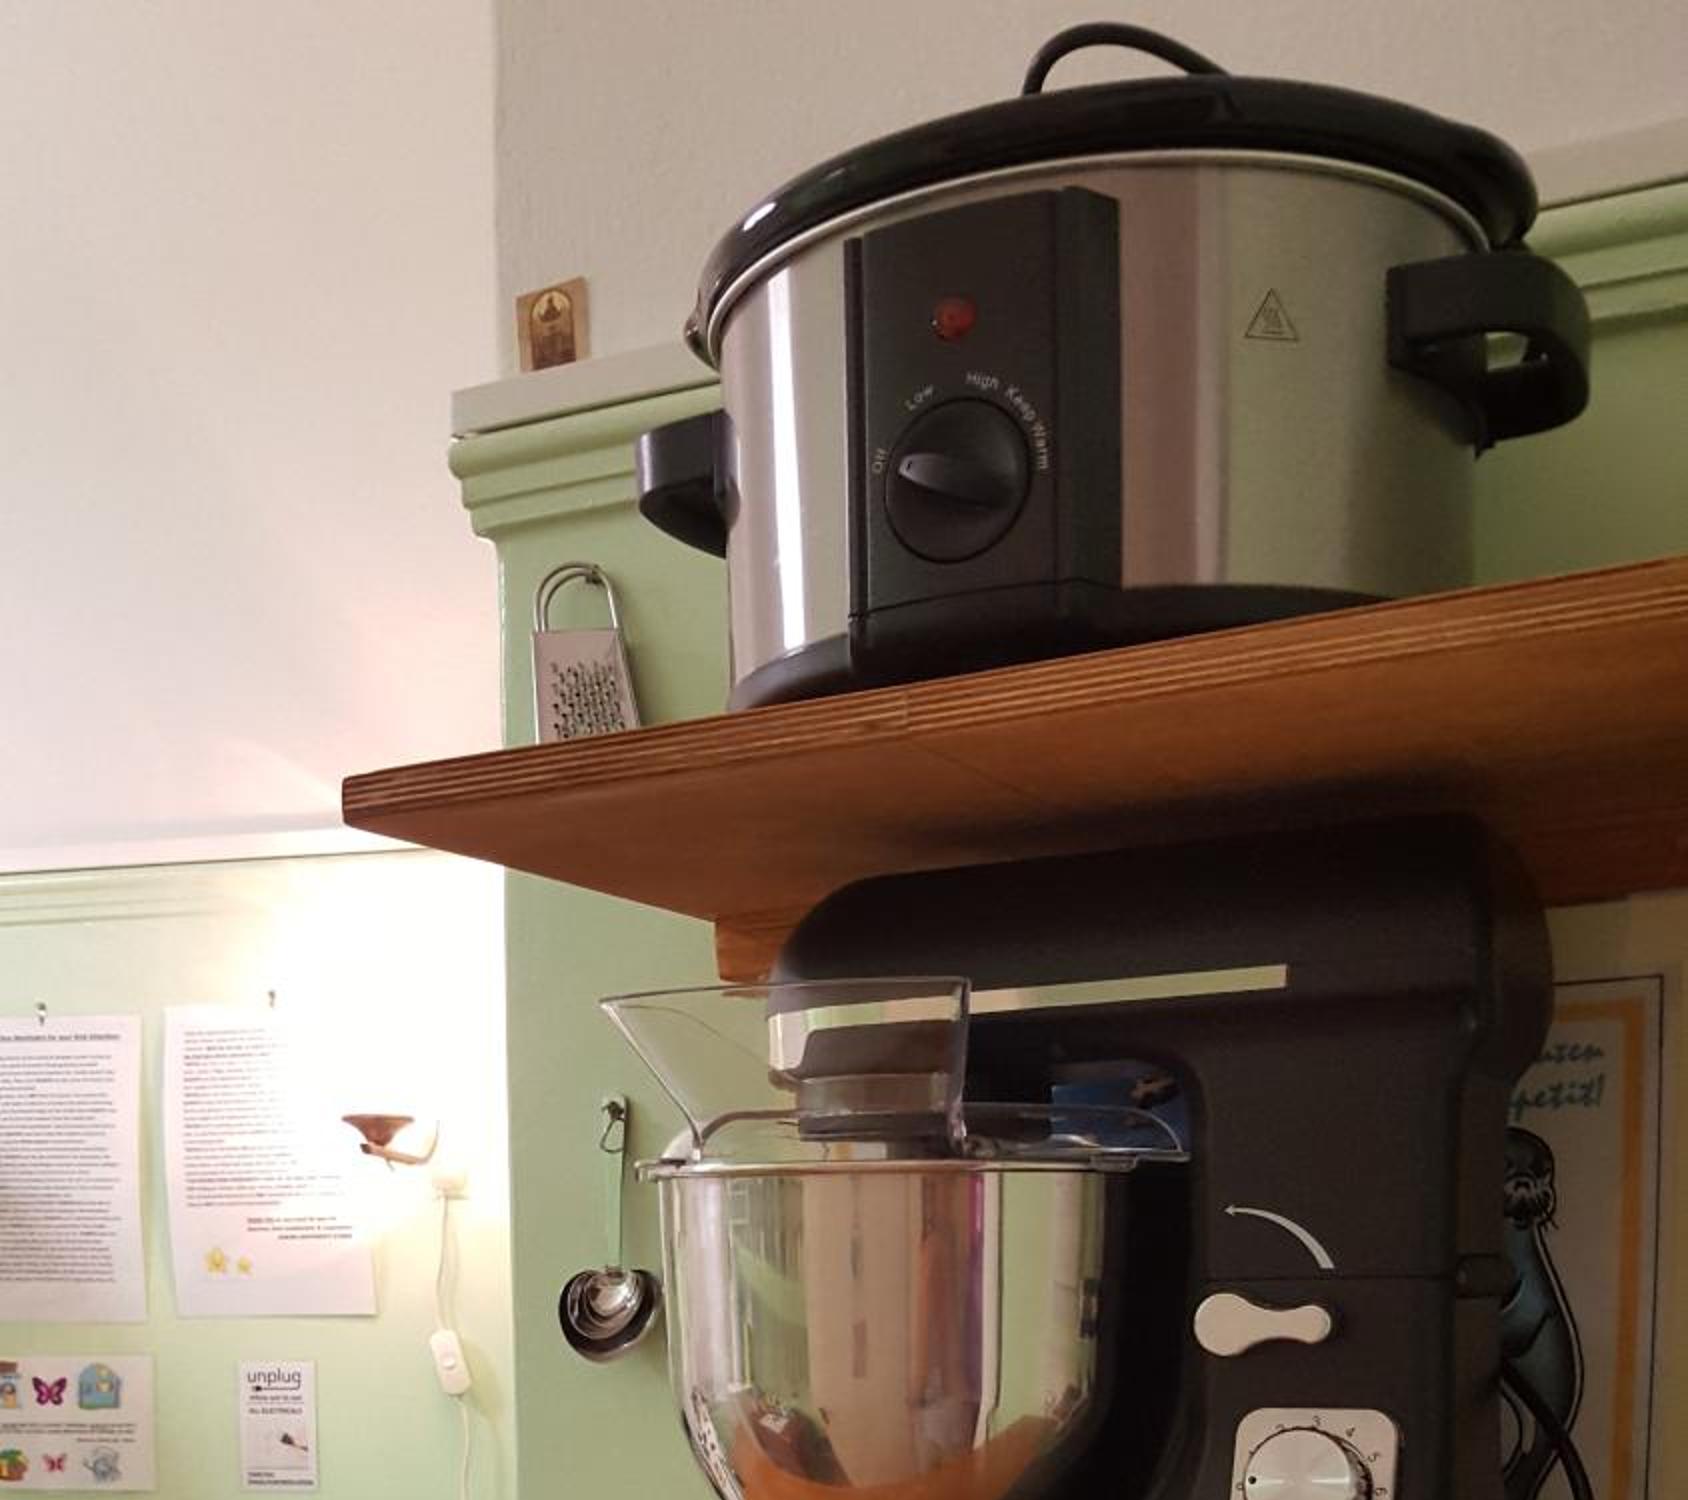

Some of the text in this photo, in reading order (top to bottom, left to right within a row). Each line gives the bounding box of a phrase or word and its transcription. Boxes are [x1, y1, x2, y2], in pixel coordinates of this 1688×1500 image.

[964, 371, 999, 391] High
[904, 384, 935, 412] Low
[1004, 386, 1049, 470] Keep Warm
[871, 448, 889, 475] Off
[246, 1367, 302, 1389] unplug
